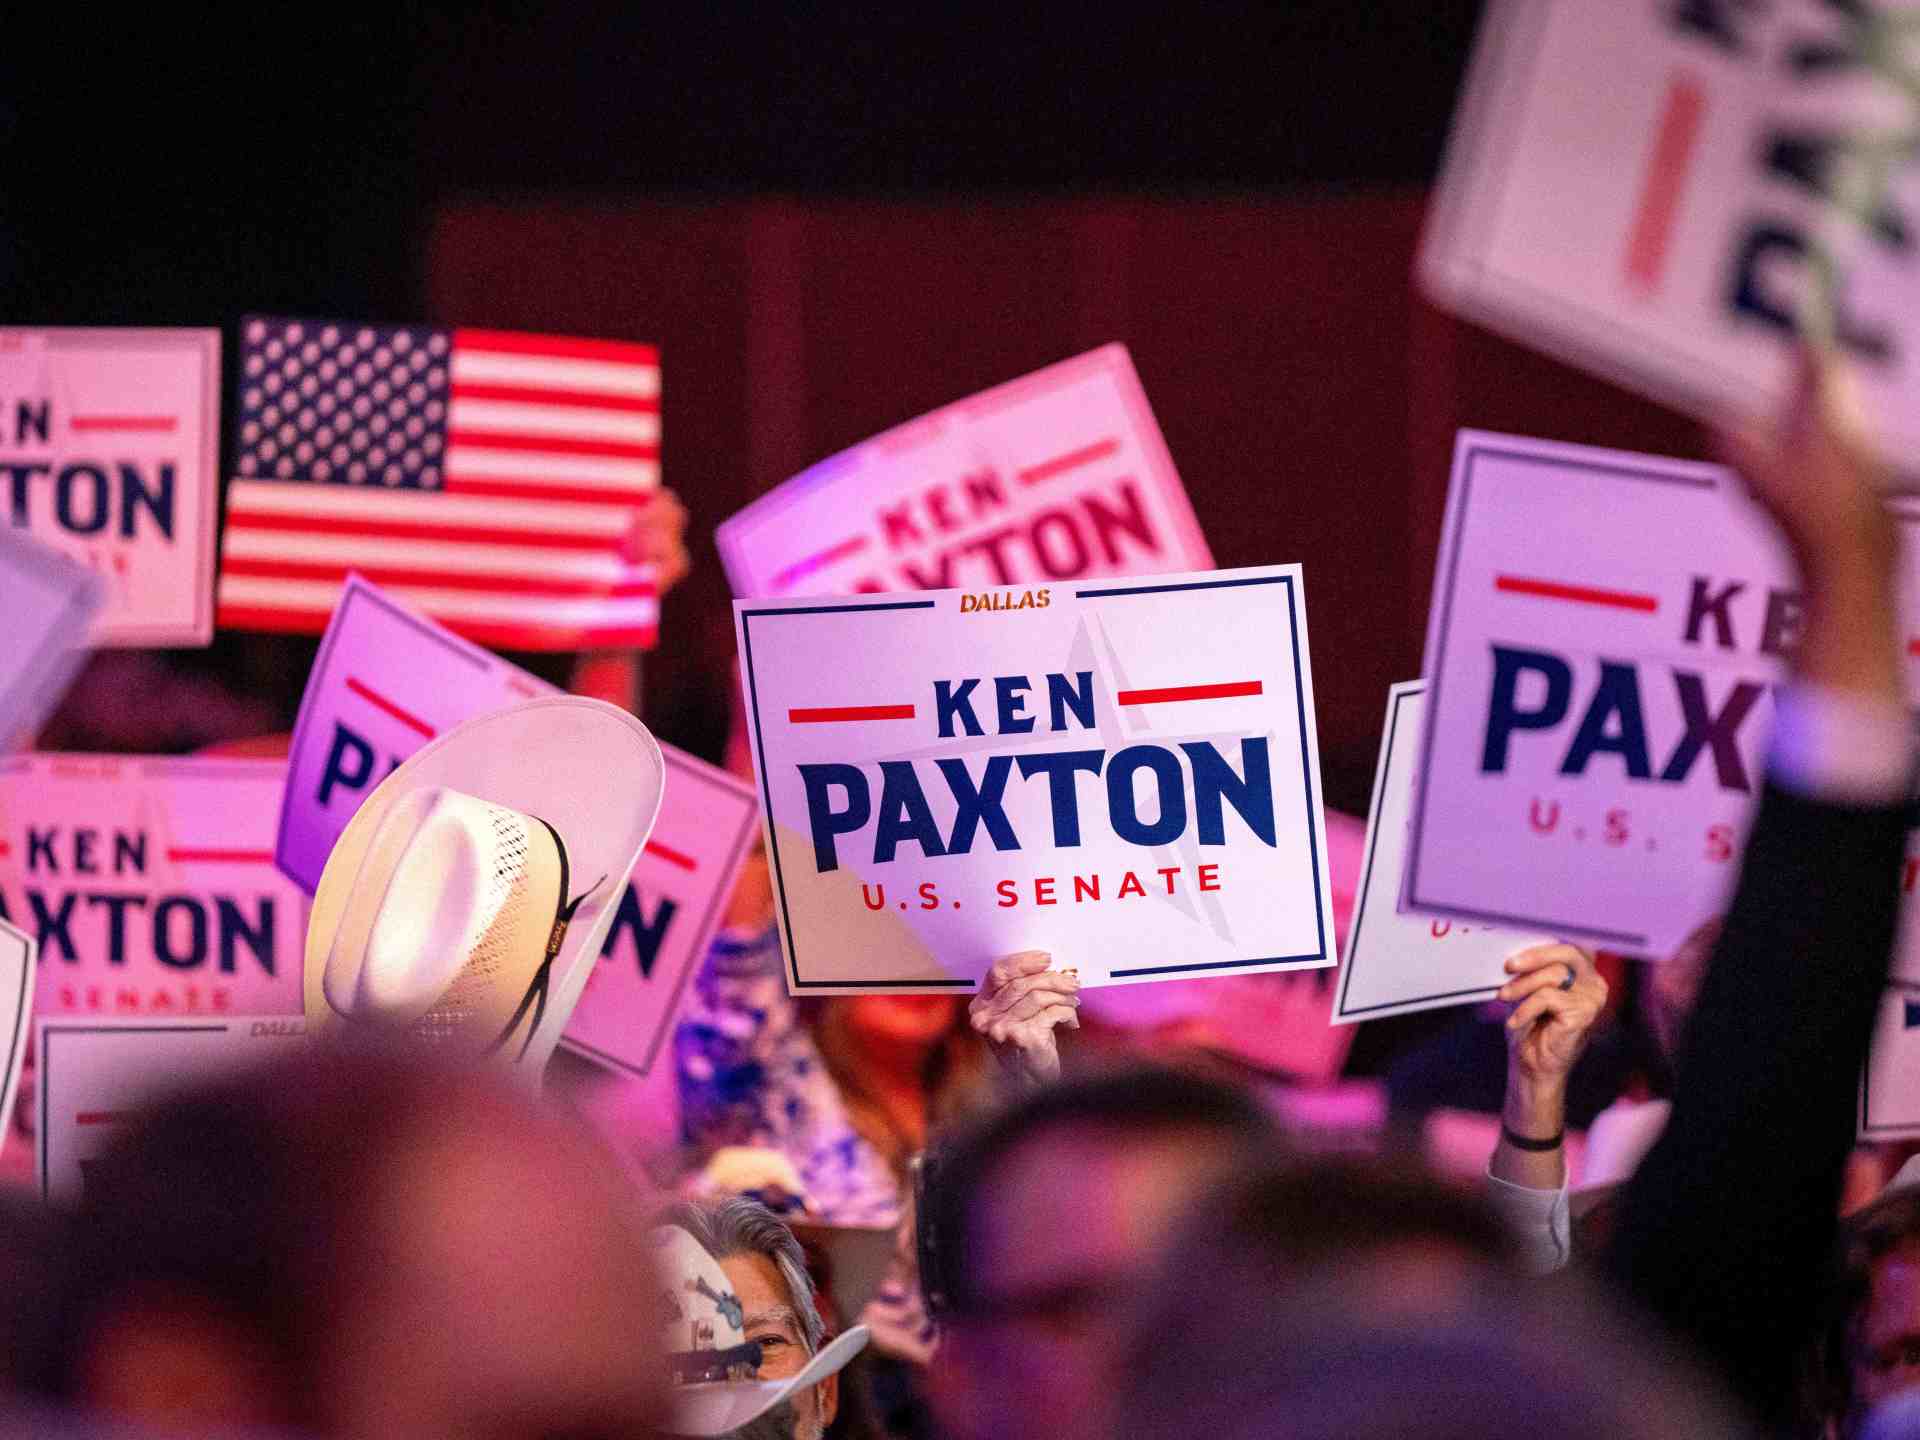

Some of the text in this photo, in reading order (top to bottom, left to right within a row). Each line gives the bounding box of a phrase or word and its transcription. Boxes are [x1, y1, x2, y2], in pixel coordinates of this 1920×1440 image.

[960, 589, 1051, 613] DALLAS
[932, 670, 1097, 739] KEN
[1479, 643, 1766, 795] PAX
[795, 736, 1278, 874] PAXTON
[1529, 797, 1658, 858] U.S.
[27, 826, 147, 875] KEN
[861, 863, 1222, 911] U.S. SENATE
[0, 888, 277, 977] XTON
